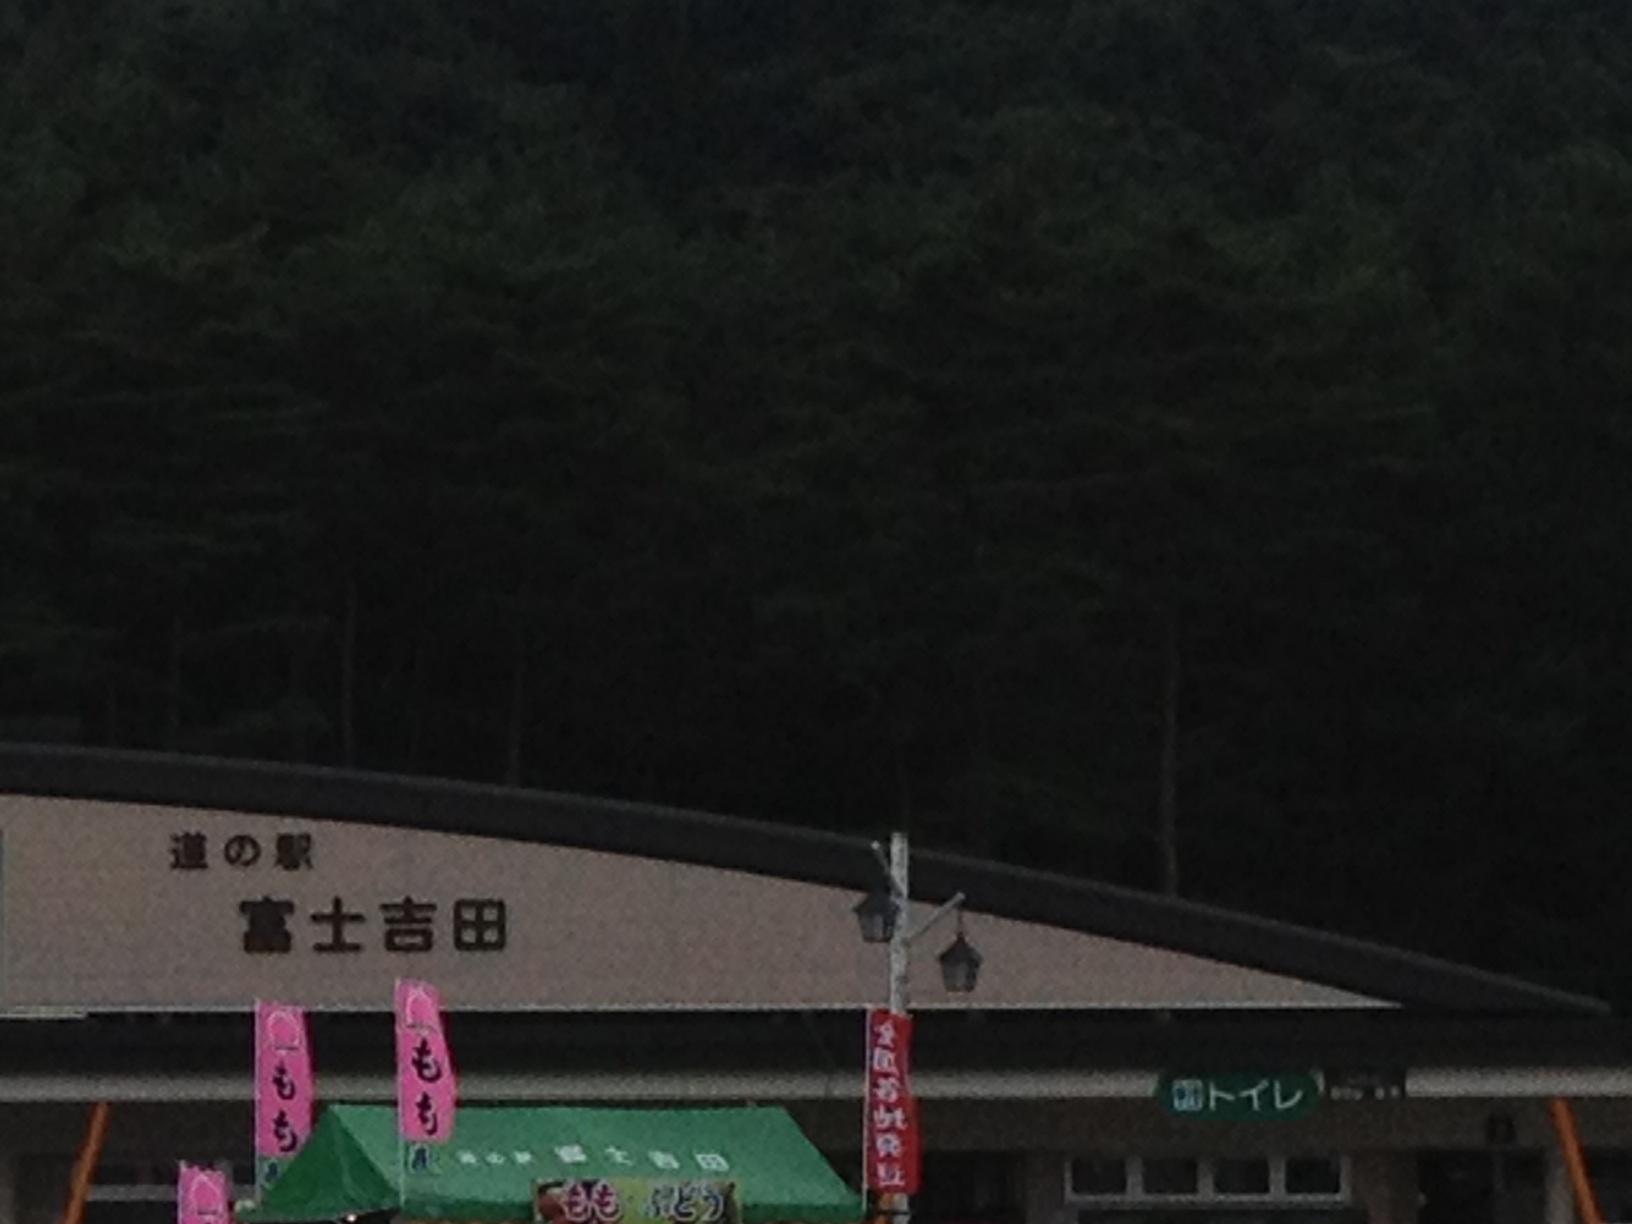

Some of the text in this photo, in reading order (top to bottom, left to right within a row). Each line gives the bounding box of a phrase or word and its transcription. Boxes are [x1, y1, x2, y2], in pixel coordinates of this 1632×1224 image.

[169, 831, 313, 870] 道の駅
[239, 895, 506, 953] 富士吉田
[272, 1062, 299, 1153] もも
[410, 1038, 442, 1136] もも
[1209, 1079, 1304, 1111] トイレ
